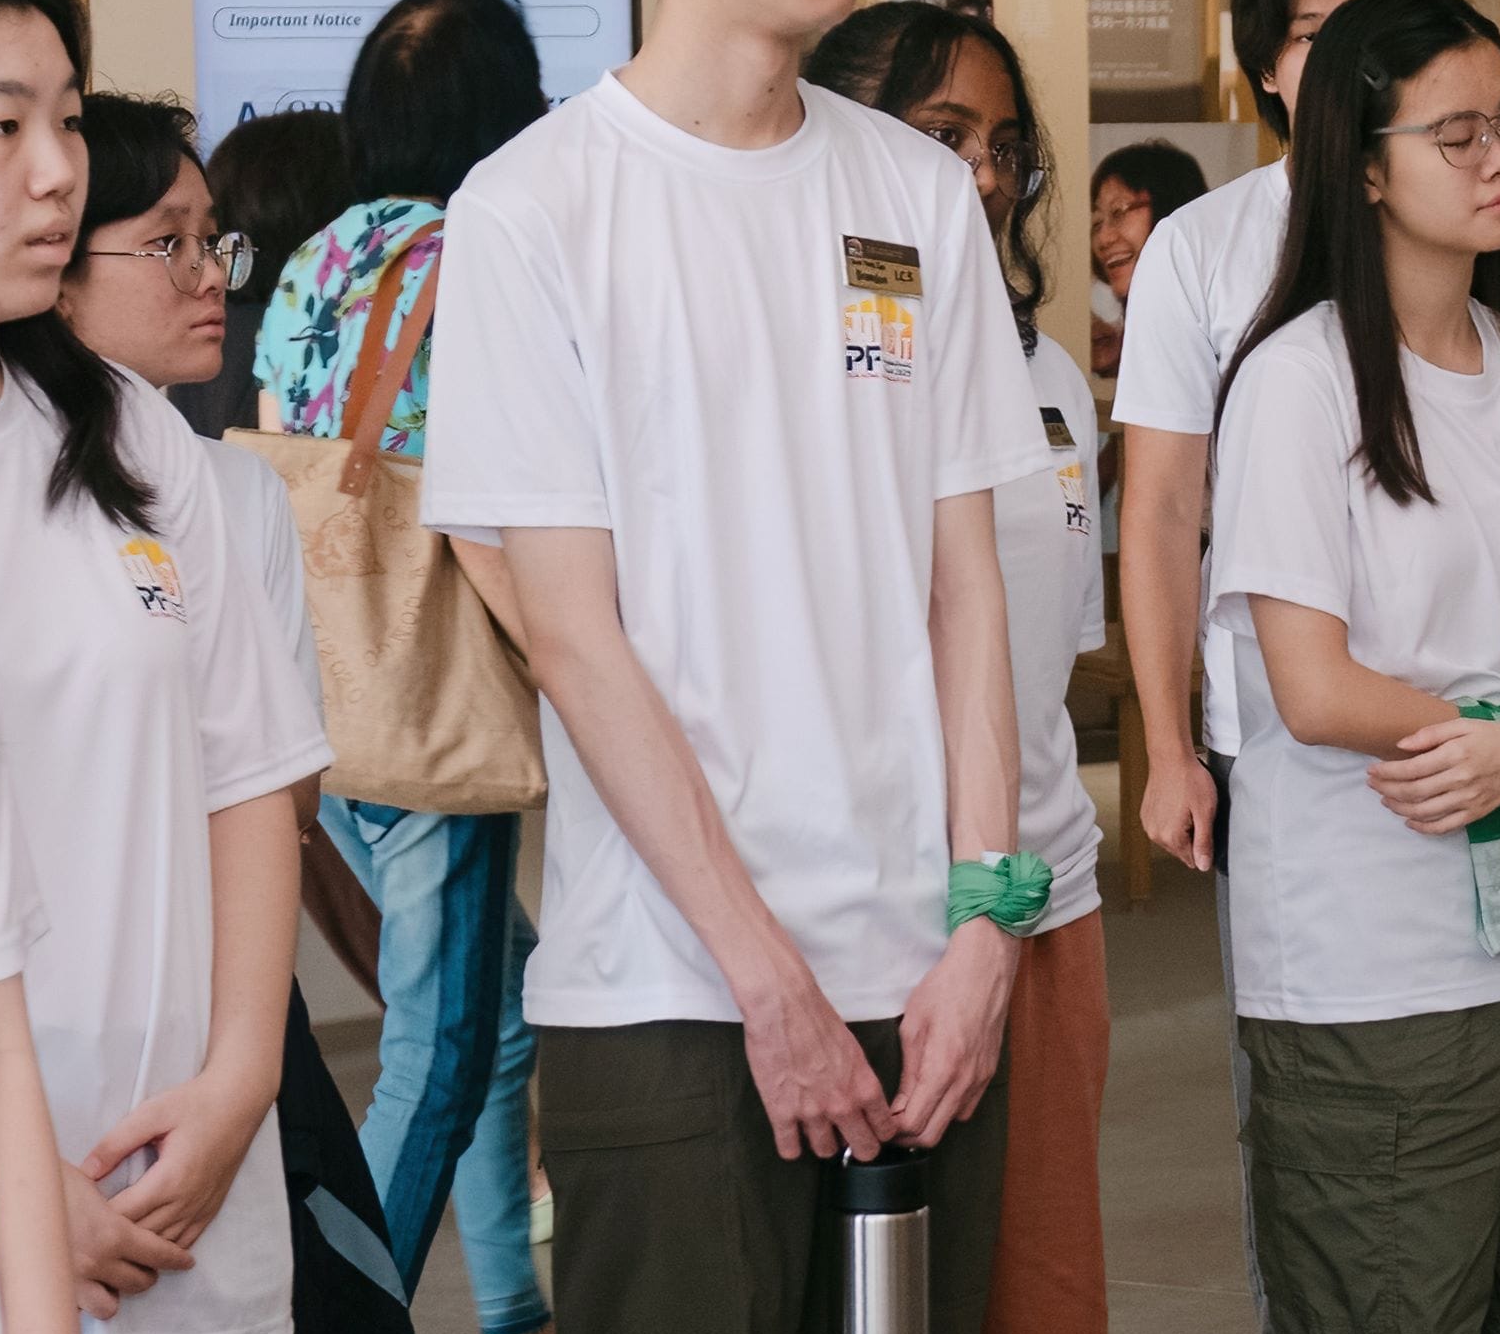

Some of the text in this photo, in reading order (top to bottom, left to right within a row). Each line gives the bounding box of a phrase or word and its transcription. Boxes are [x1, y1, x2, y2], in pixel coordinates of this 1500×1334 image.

[229, 13, 362, 30] Important Notice
[846, 345, 881, 371] PF
[135, 585, 166, 610] PF
